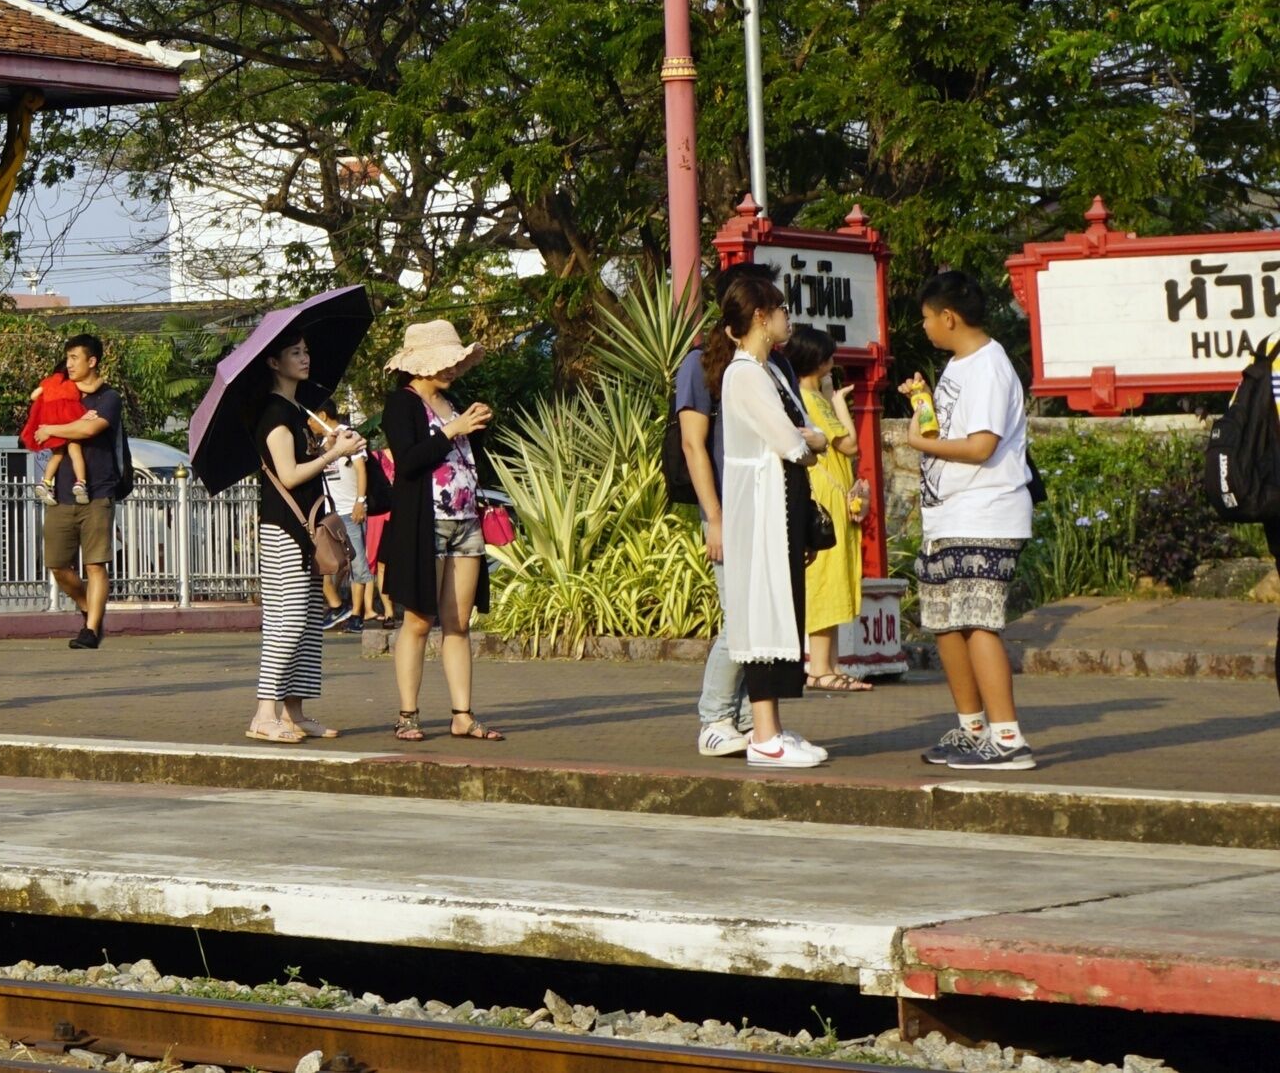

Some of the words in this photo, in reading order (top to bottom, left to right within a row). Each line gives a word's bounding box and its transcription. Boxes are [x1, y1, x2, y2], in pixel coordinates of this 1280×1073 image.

[783, 253, 854, 318] หัวหิน
[1191, 329, 1256, 359] HUA
[1219, 453, 1230, 493] SPORT
